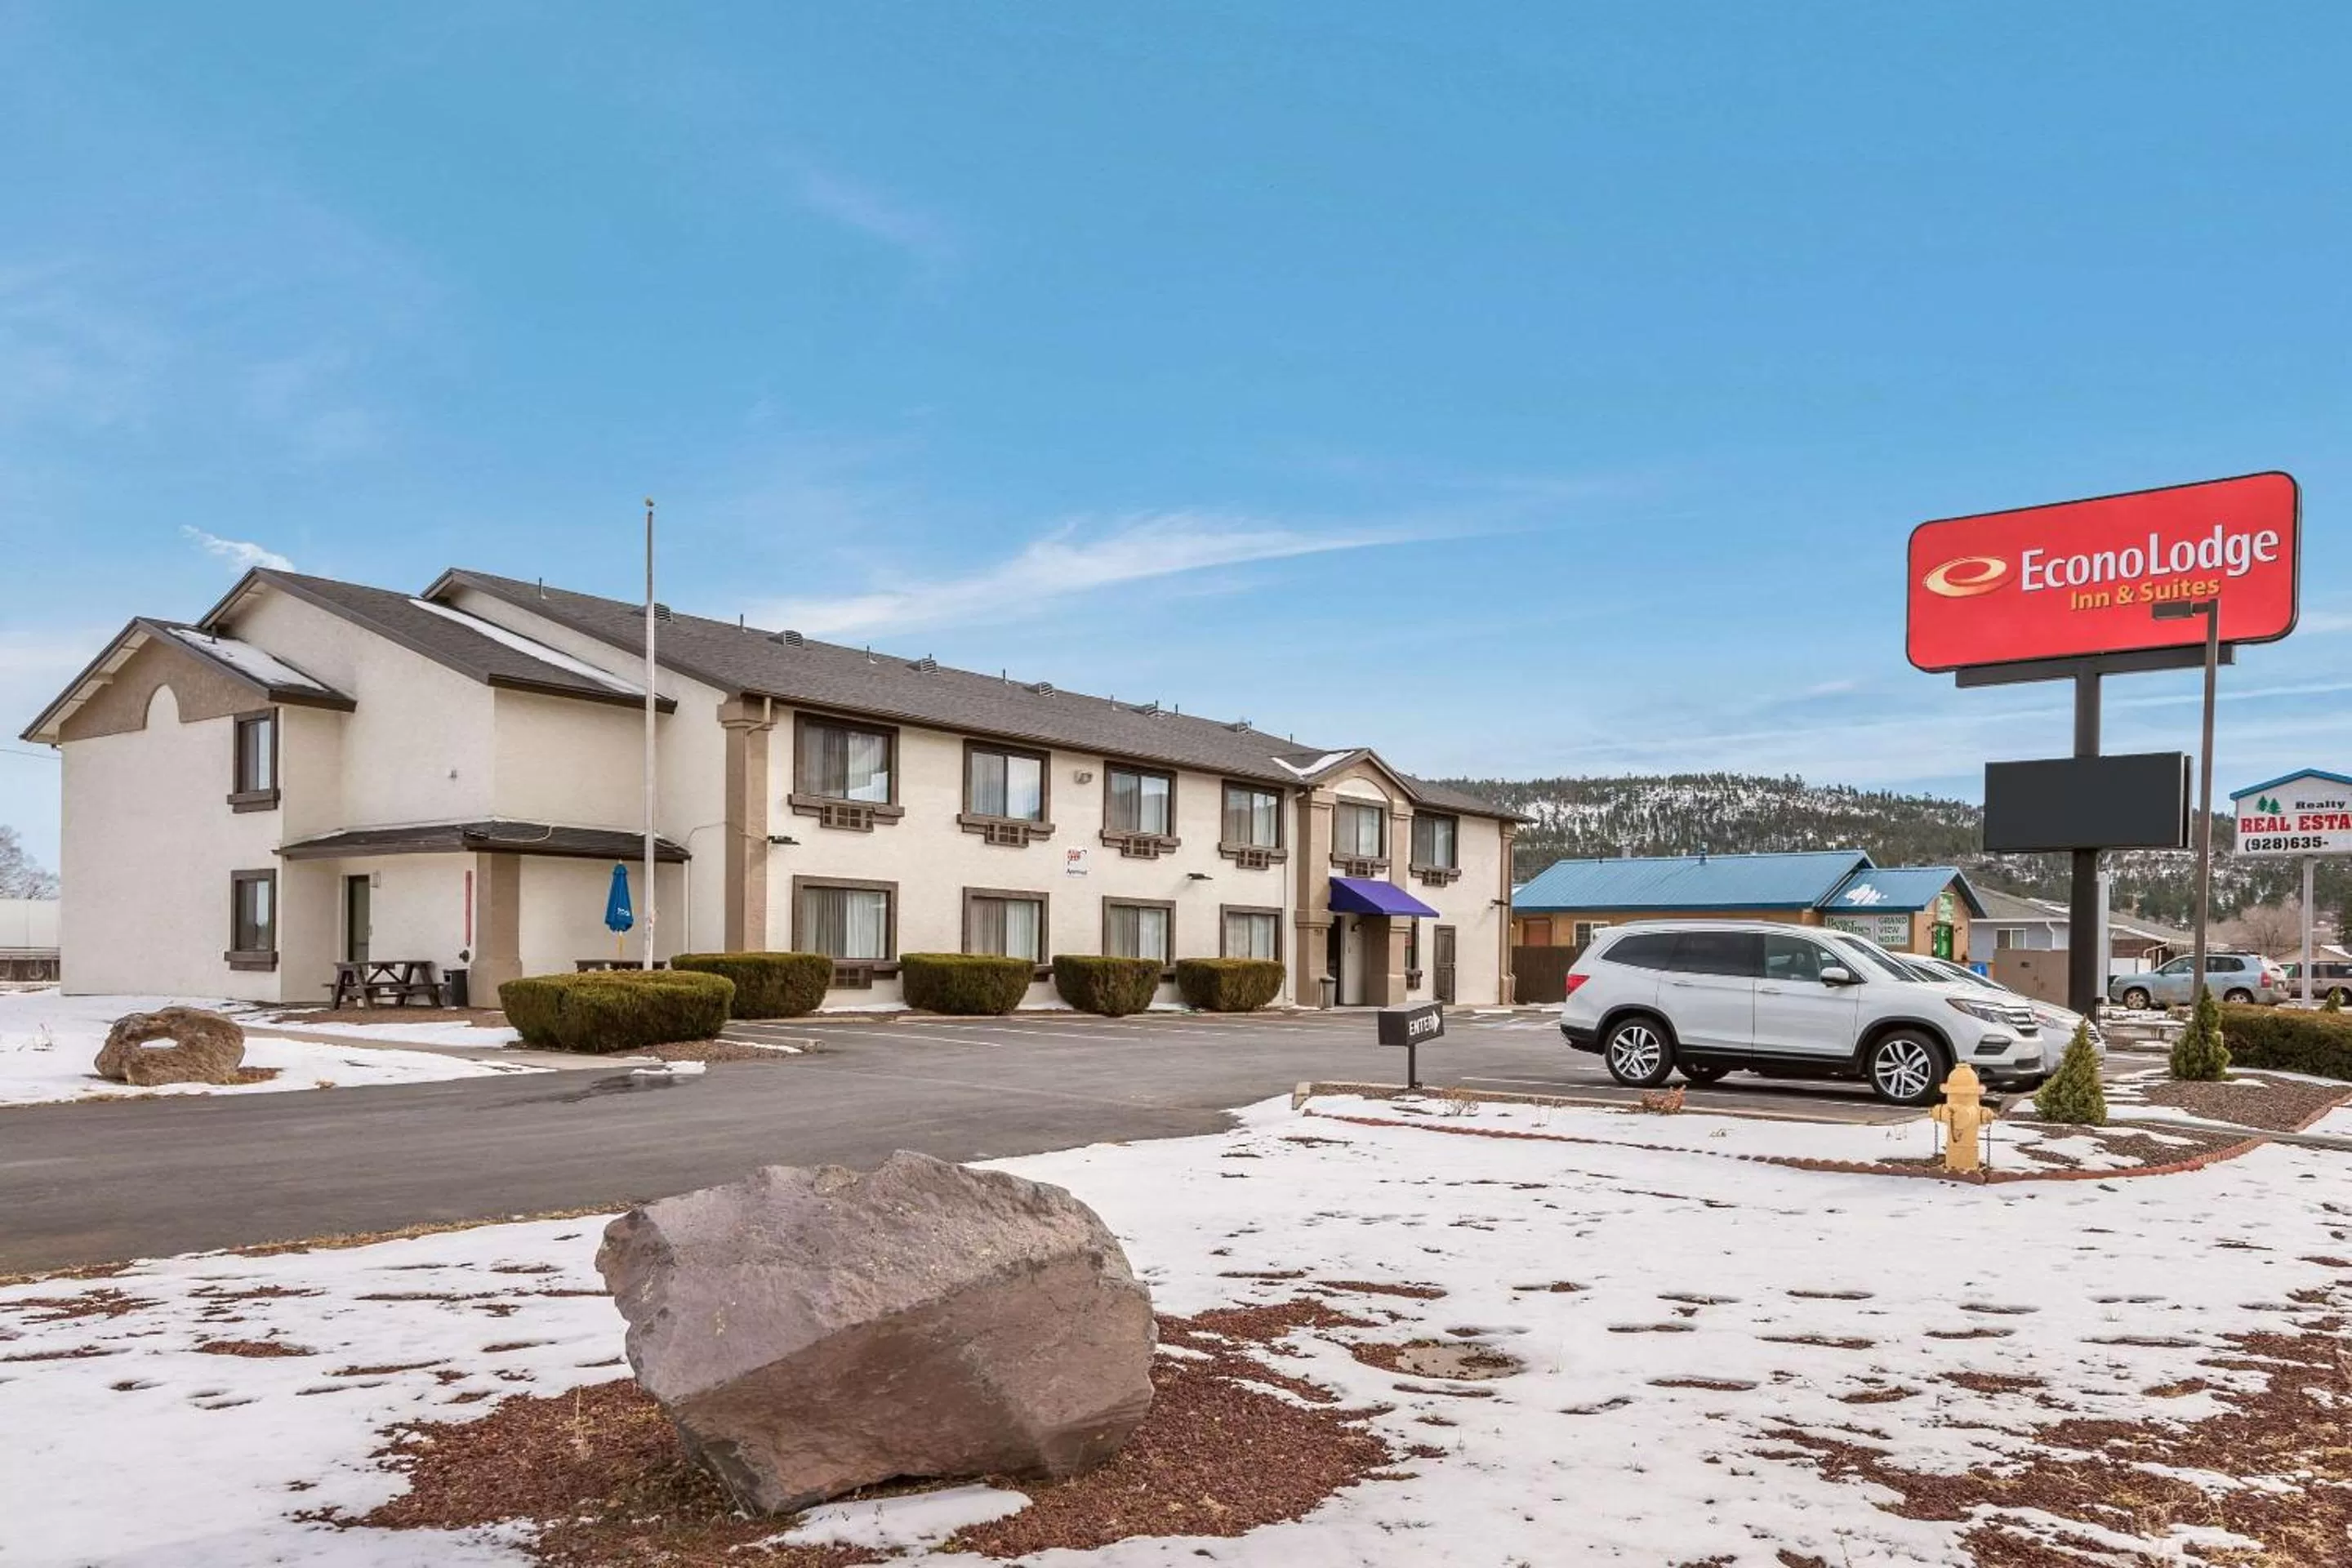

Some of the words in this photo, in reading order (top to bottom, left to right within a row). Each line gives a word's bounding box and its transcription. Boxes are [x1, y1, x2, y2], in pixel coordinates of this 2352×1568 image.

[2069, 590, 2110, 611] Inn
[2116, 585, 2134, 604] &
[2139, 577, 2221, 602] Suites
[2296, 800, 2346, 809] Realty
[2241, 816, 2292, 833] REAL
[2299, 813, 2352, 831] ESTA
[2245, 835, 2329, 852] (928)635-
[1878, 916, 1908, 924] GRAND
[1878, 935, 1906, 943] NORTH
[1409, 1015, 1433, 1036] ENTER
